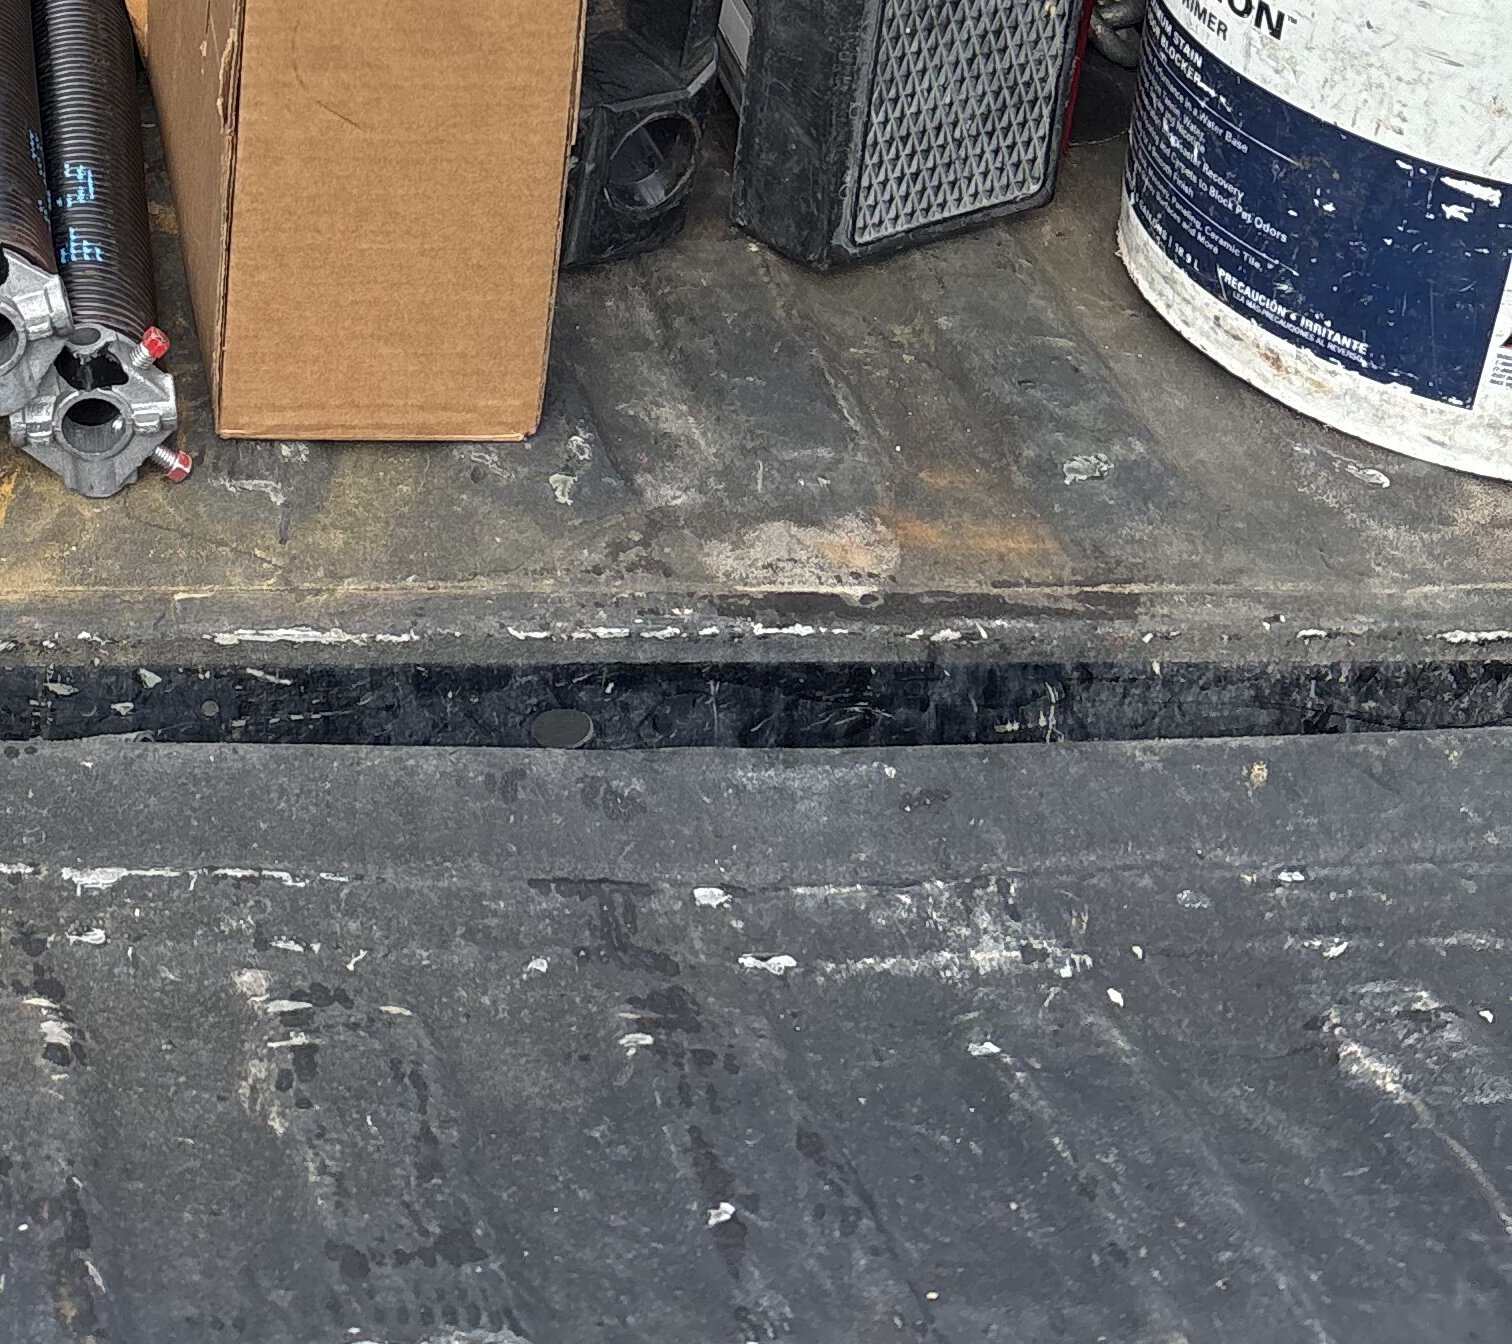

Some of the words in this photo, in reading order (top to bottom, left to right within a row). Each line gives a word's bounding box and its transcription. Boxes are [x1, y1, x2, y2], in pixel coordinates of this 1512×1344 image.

[1161, 38, 1201, 84] BLOCKER
[1173, 31, 1202, 68] STAIN
[1199, 111, 1223, 137] Water
[1225, 131, 1248, 154] Base
[1202, 164, 1244, 202] Recovery
[1198, 178, 1208, 191] to
[1209, 186, 1233, 210] Block
[1254, 216, 1287, 243] Odors
[1204, 226, 1240, 257] Ceramic
[1194, 259, 1199, 272] L
[1219, 267, 1287, 318] PRECAUCIÓN
[1300, 315, 1369, 355] IRRITANTE
